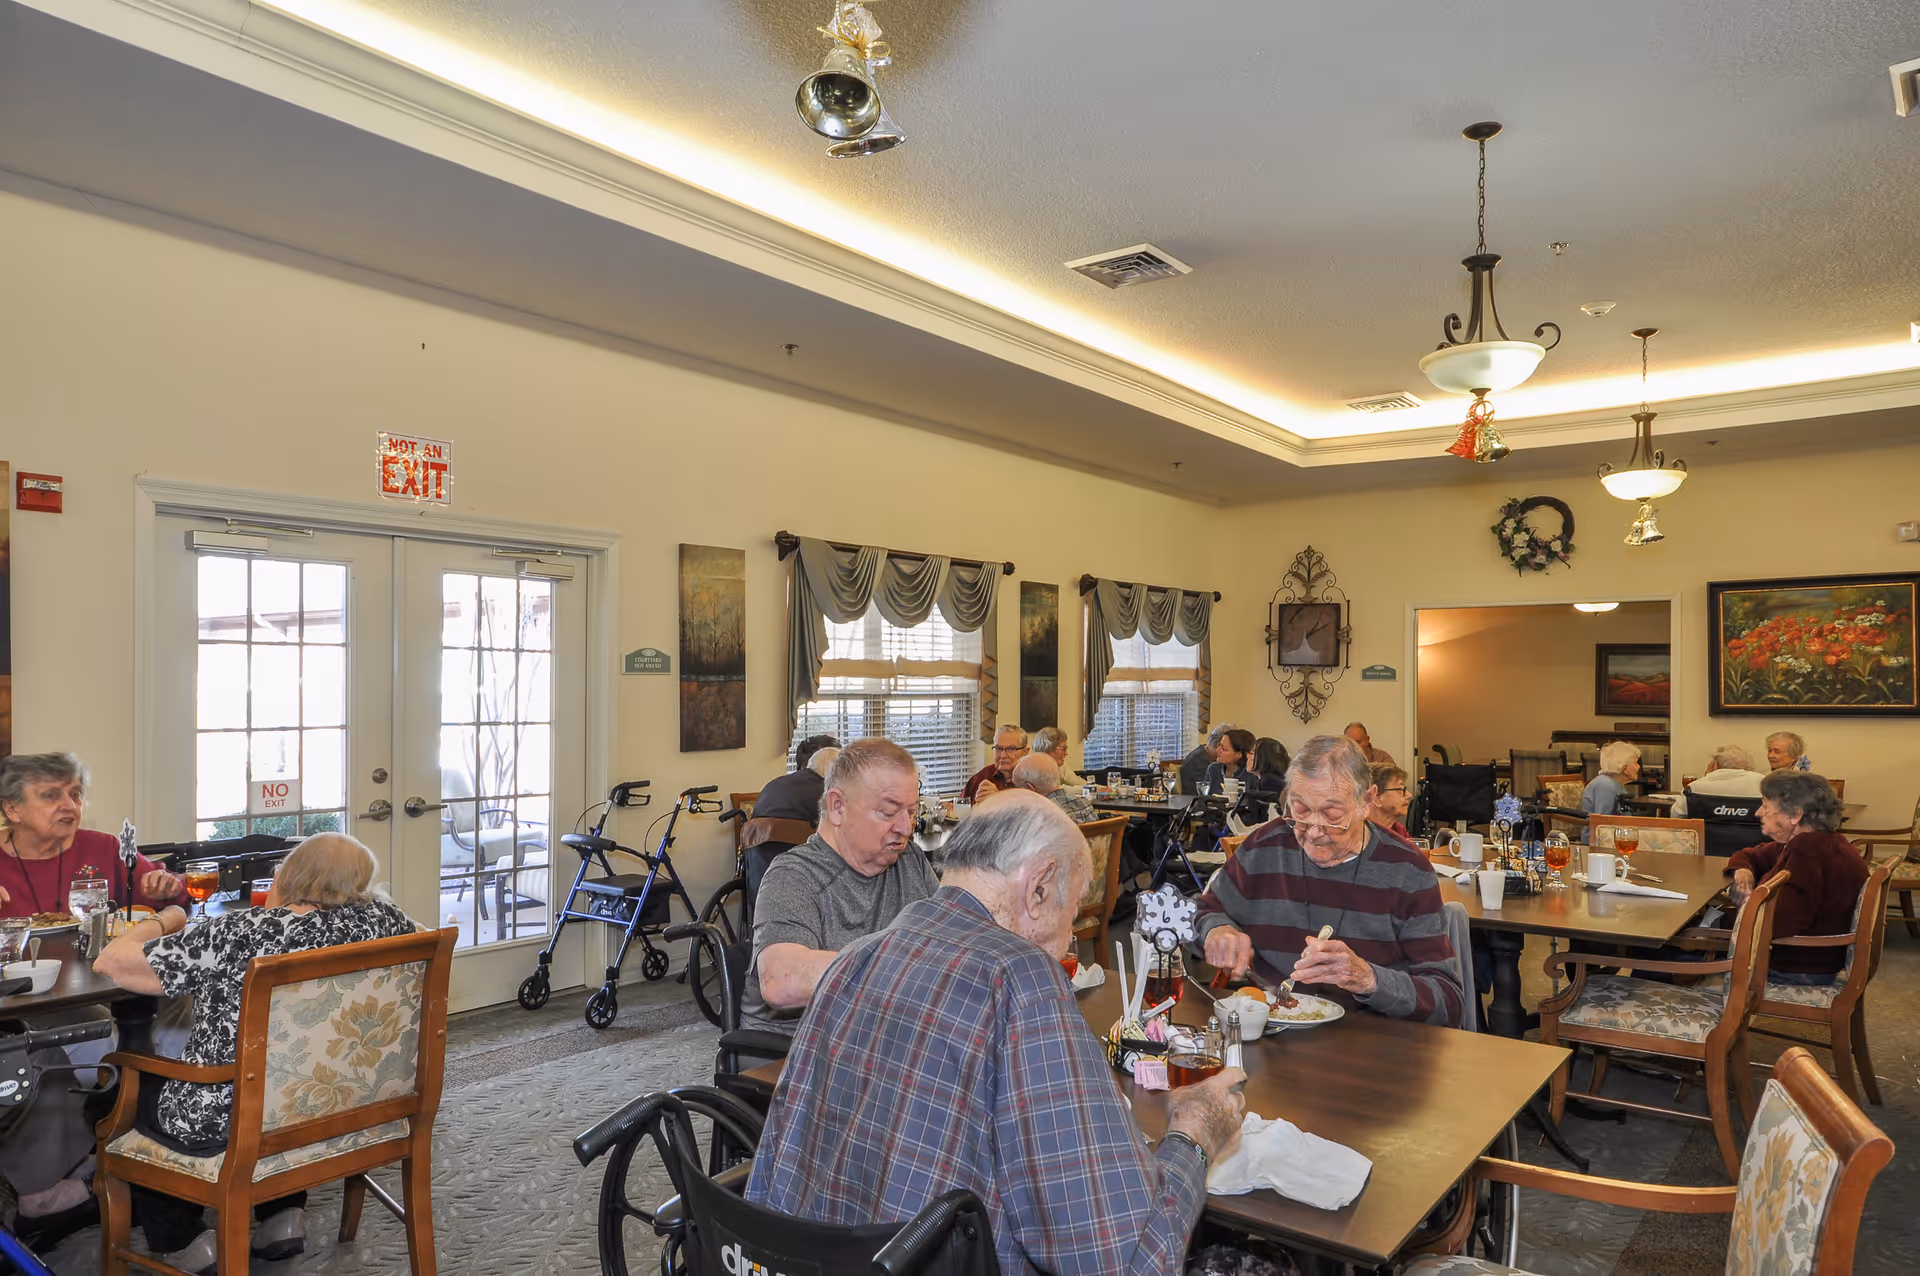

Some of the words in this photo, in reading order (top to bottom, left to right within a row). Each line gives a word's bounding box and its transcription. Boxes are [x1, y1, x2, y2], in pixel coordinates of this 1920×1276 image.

[388, 437, 417, 455] NOT
[423, 443, 442, 458] AN
[382, 454, 448, 499] EXIT
[262, 783, 289, 799] NO
[264, 799, 287, 808] EXIT
[1713, 805, 1749, 816] drive
[1162, 910, 1171, 923] 6
